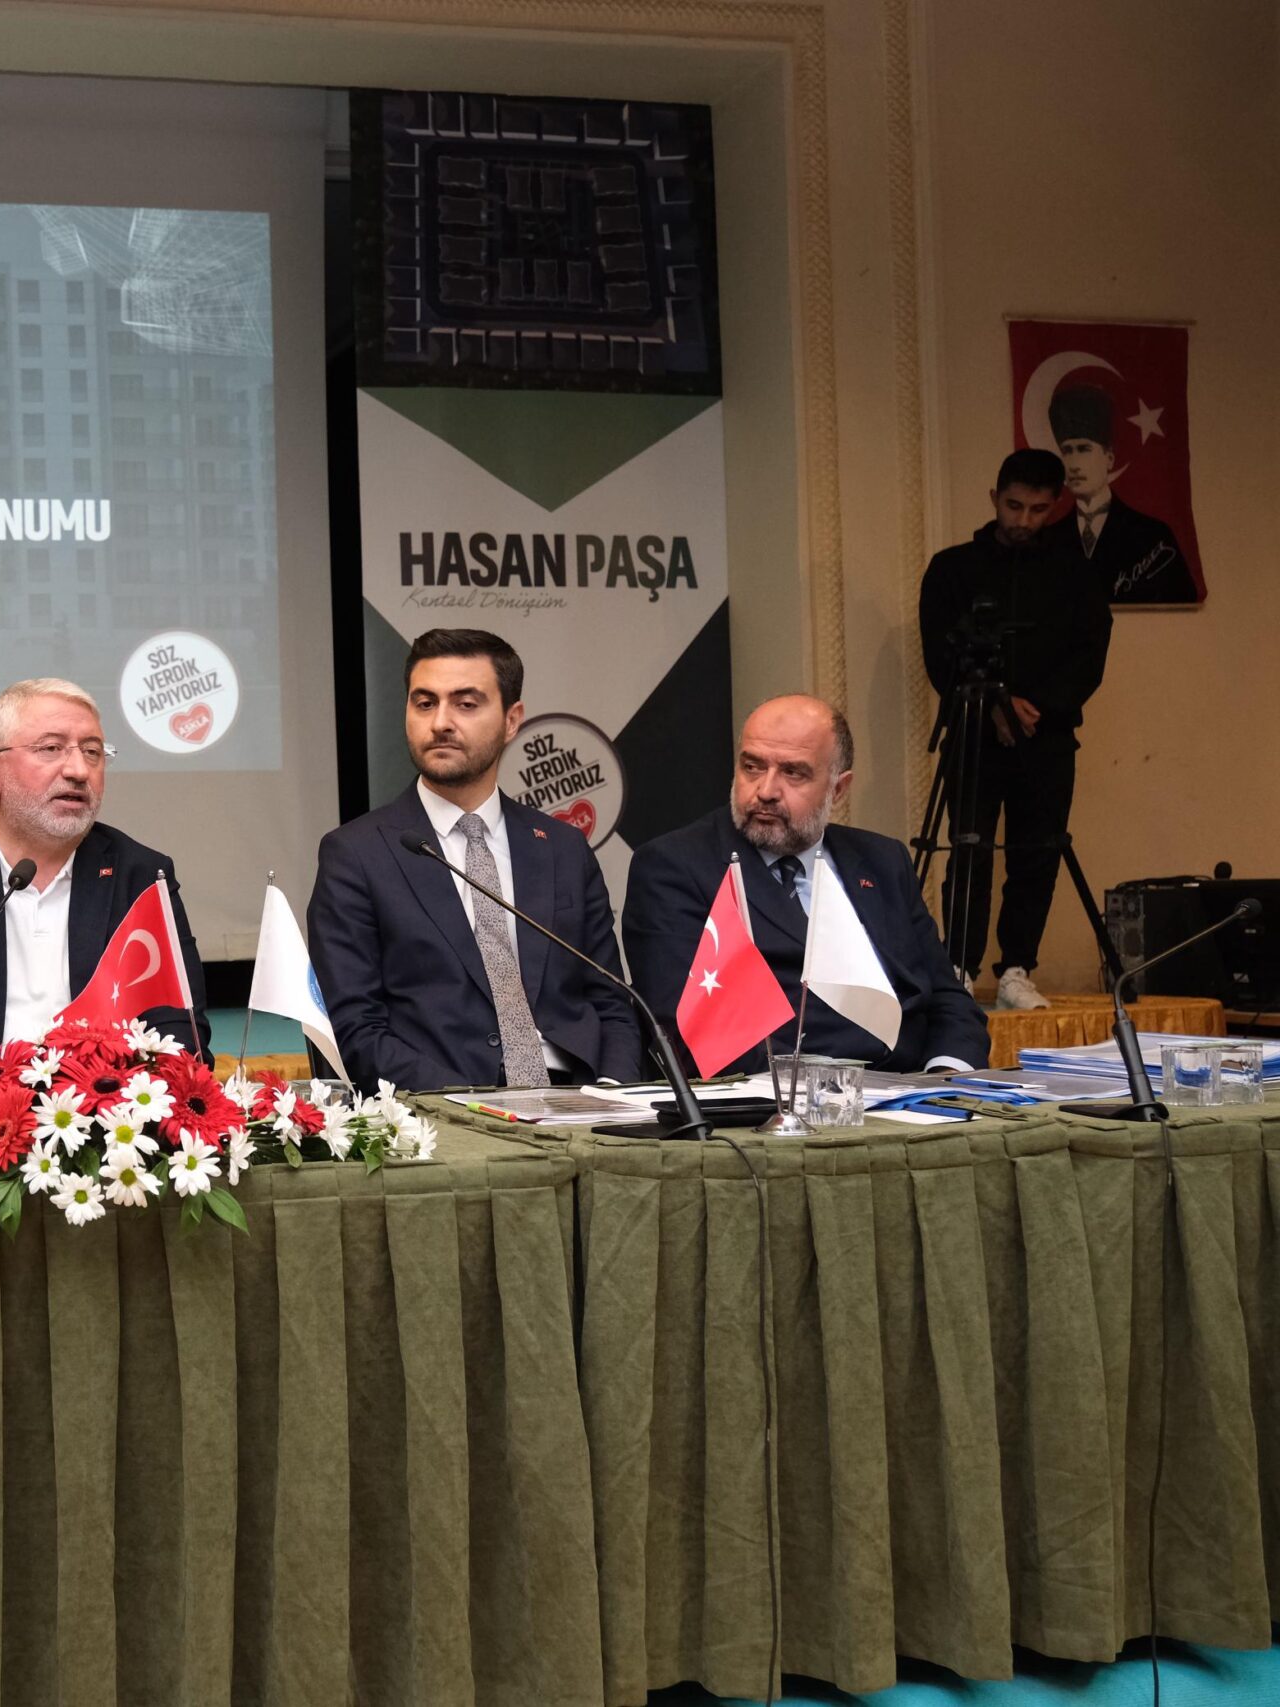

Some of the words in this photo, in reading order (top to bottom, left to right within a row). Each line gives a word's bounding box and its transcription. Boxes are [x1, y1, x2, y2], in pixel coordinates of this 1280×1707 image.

[400, 532, 567, 588] HASAN
[576, 534, 699, 603] PAŞA
[143, 658, 200, 692] VERDİK
[147, 645, 180, 669] SÖZ
[136, 672, 222, 717] YAPIYORUZ
[523, 733, 559, 761] SÖZ
[518, 748, 582, 788] VERDİK
